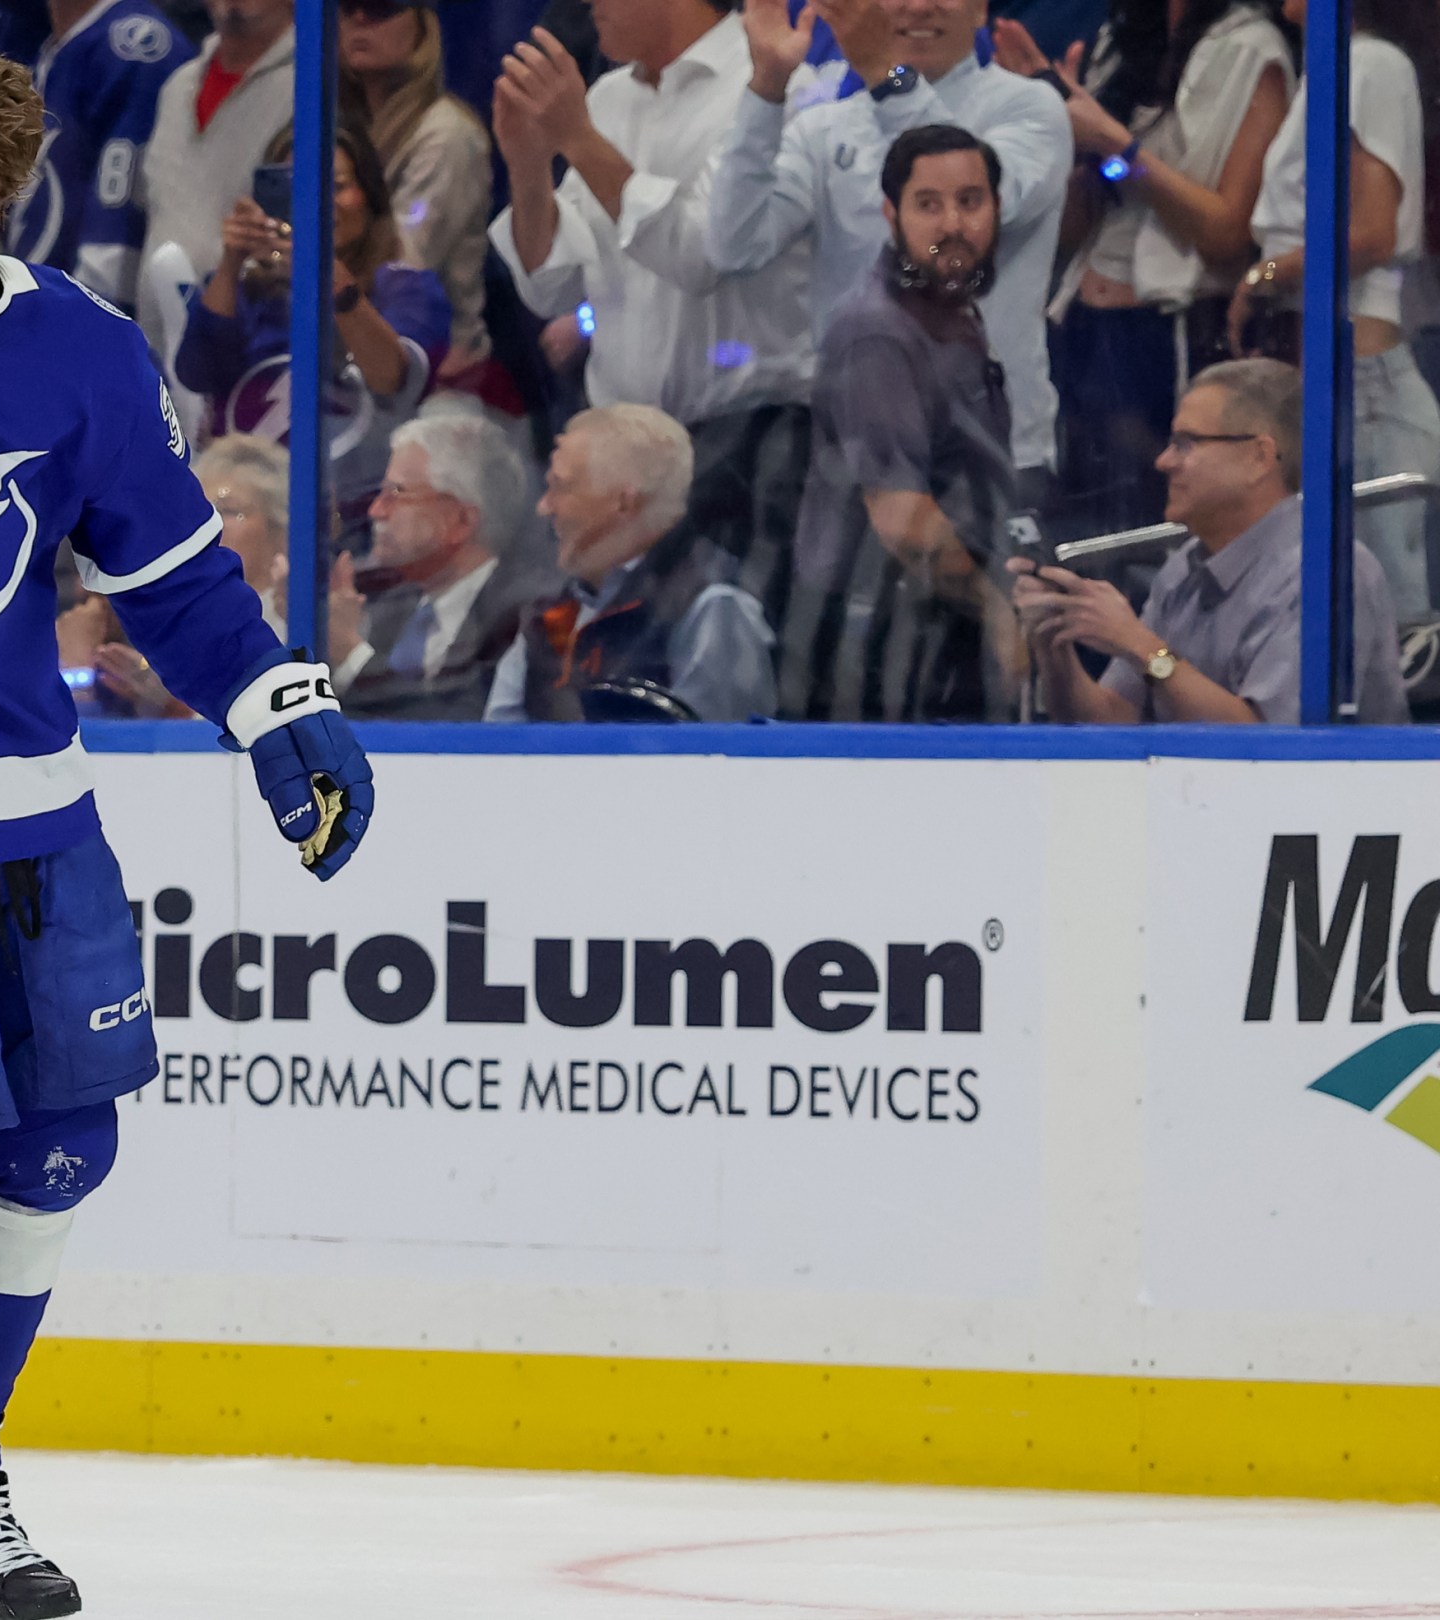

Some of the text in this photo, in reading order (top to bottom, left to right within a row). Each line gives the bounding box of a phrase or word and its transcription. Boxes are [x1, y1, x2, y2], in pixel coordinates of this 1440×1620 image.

[271, 679, 336, 712] CC
[280, 801, 313, 828] CCM
[128, 887, 982, 1034] icroLumen
[133, 1054, 981, 1123] ERFORMANCE MEDICAL DEVICES
